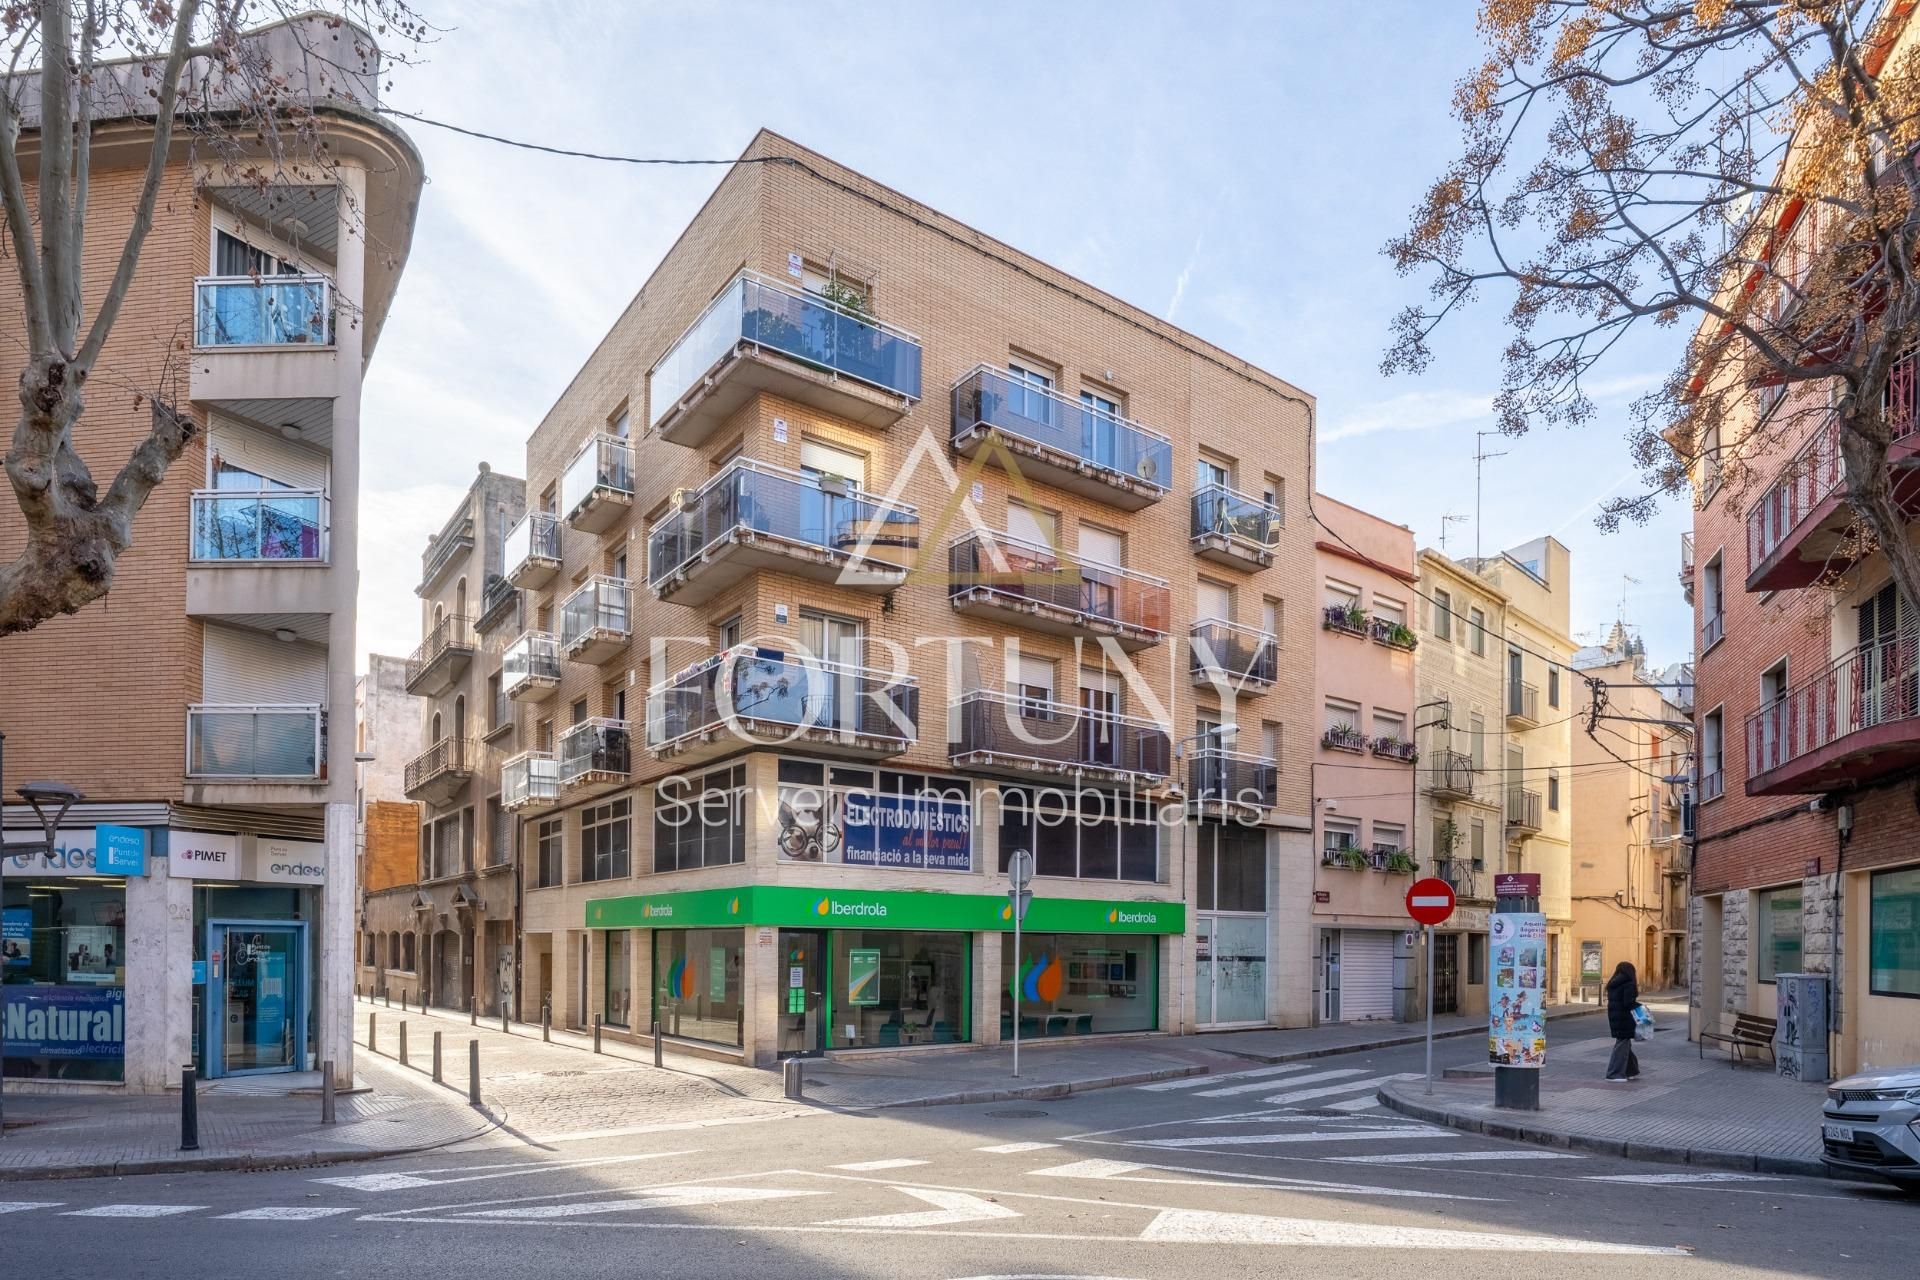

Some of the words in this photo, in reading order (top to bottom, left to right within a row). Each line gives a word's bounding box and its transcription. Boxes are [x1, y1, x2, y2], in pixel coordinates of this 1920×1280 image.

[848, 803, 969, 833] ELECTRODOMÈSTICS
[194, 850, 226, 863] PIMET
[847, 845, 902, 864] financiació
[904, 853, 910, 863] a
[912, 850, 921, 864] la
[924, 853, 945, 866] seva
[947, 851, 969, 867] mida
[650, 904, 673, 917] Iberdrola
[831, 901, 887, 916] Iberdrola
[1118, 911, 1157, 924] Iberdrola
